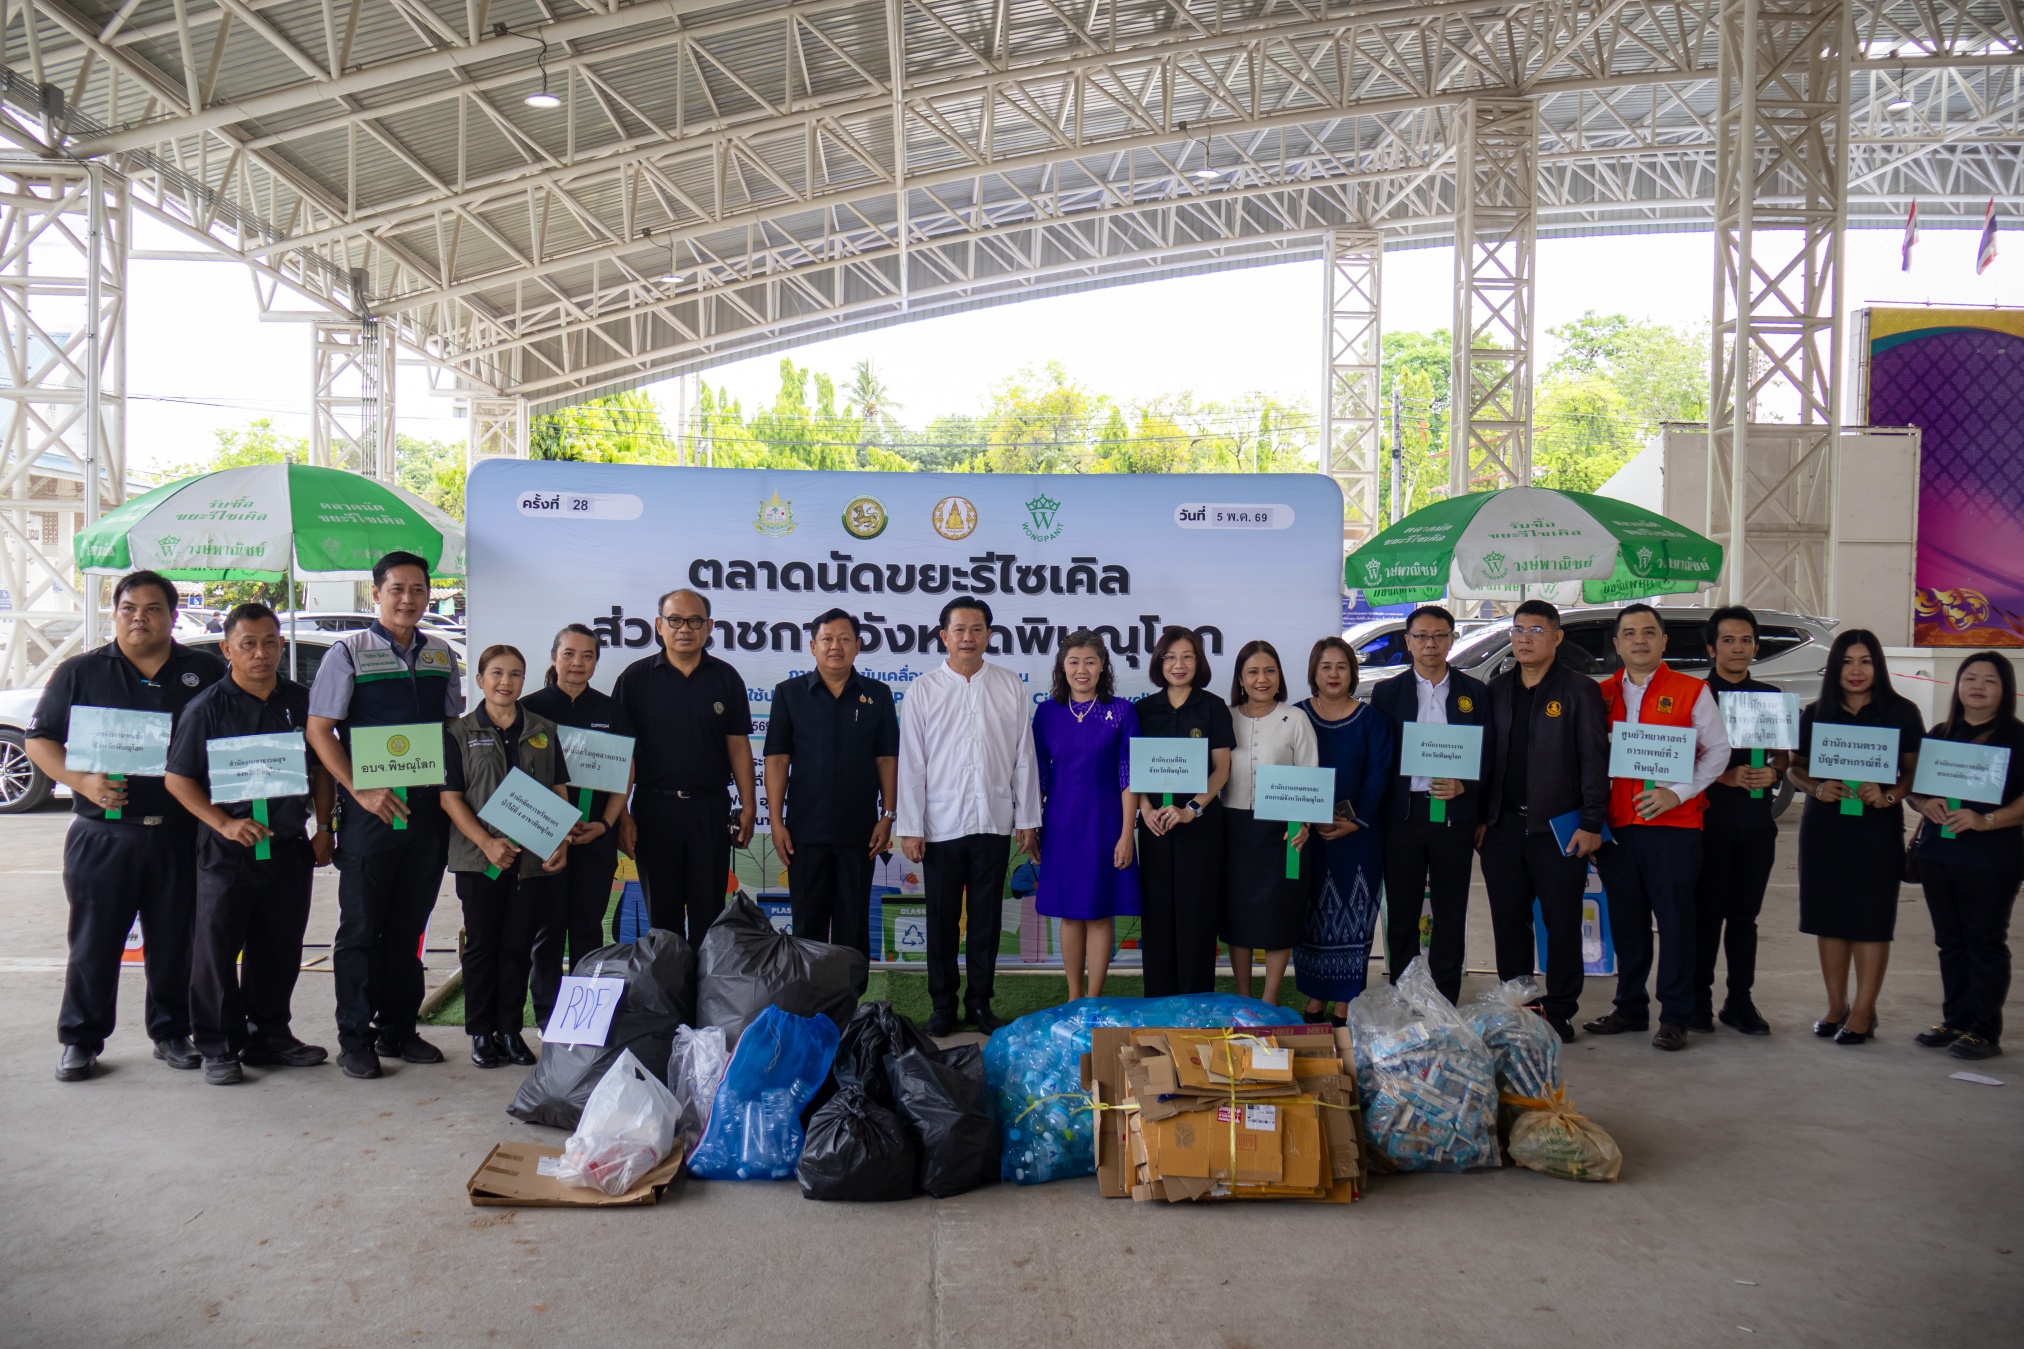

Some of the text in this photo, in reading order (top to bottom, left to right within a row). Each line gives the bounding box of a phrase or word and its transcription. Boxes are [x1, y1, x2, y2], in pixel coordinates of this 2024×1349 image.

[209, 495, 254, 508] รับซื้อ
[319, 501, 386, 512] ตลาดนัด
[522, 493, 589, 511] ครั้งที่ 28
[176, 510, 268, 521] ขยะรีไซเคิล
[317, 513, 406, 525] ขยะรีไซเคิล
[1179, 505, 1268, 522] วันที่ 5 พ.ค. 69
[1509, 517, 1556, 529] รับซื้อ
[1022, 522, 1064, 543] WONGPANIT
[1488, 529, 1582, 539] ขยะรีไซเคิล
[187, 539, 267, 557] วงษ์พาณิชย์
[1513, 554, 1594, 572] วงษ์พาณิชย์
[688, 550, 1130, 595] ตลาดนัดขยะรีไซเคิล
[1621, 729, 1687, 743] ศูนย์วิทยาศาสตร์
[1822, 737, 1888, 751] สำนักงานตรวจ
[1626, 745, 1679, 759] การแพทย์ที่ 2
[361, 757, 436, 773] อบจ.พิษณุโลก
[1818, 753, 1881, 768] บัญชีสหกรณ์ที่
[1633, 761, 1670, 775] พิษณุโลก
[560, 985, 611, 1031] RDF
